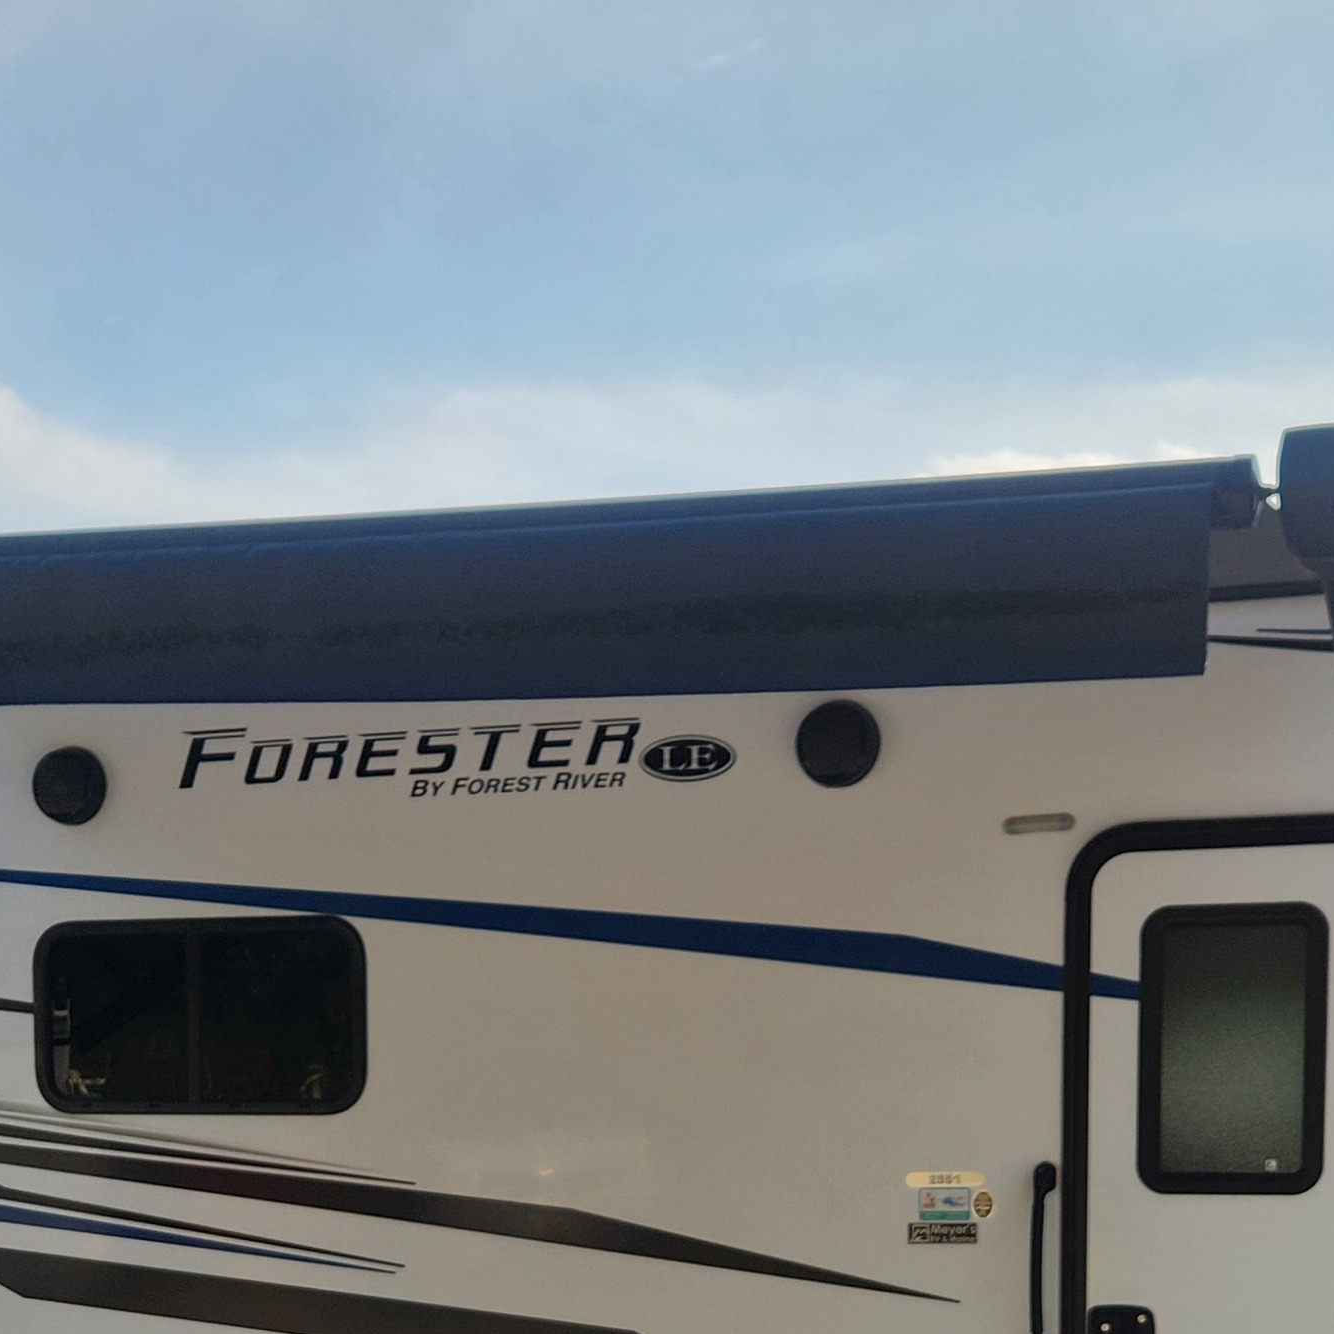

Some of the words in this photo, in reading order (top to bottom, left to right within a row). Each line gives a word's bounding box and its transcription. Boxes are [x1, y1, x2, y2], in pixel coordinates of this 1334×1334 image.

[178, 717, 641, 789] FORESTER
[658, 743, 719, 772] LE
[410, 779, 447, 798] BY
[451, 775, 547, 796] FOREST
[553, 771, 626, 791] RIVER
[930, 1224, 976, 1236] Meyer's
